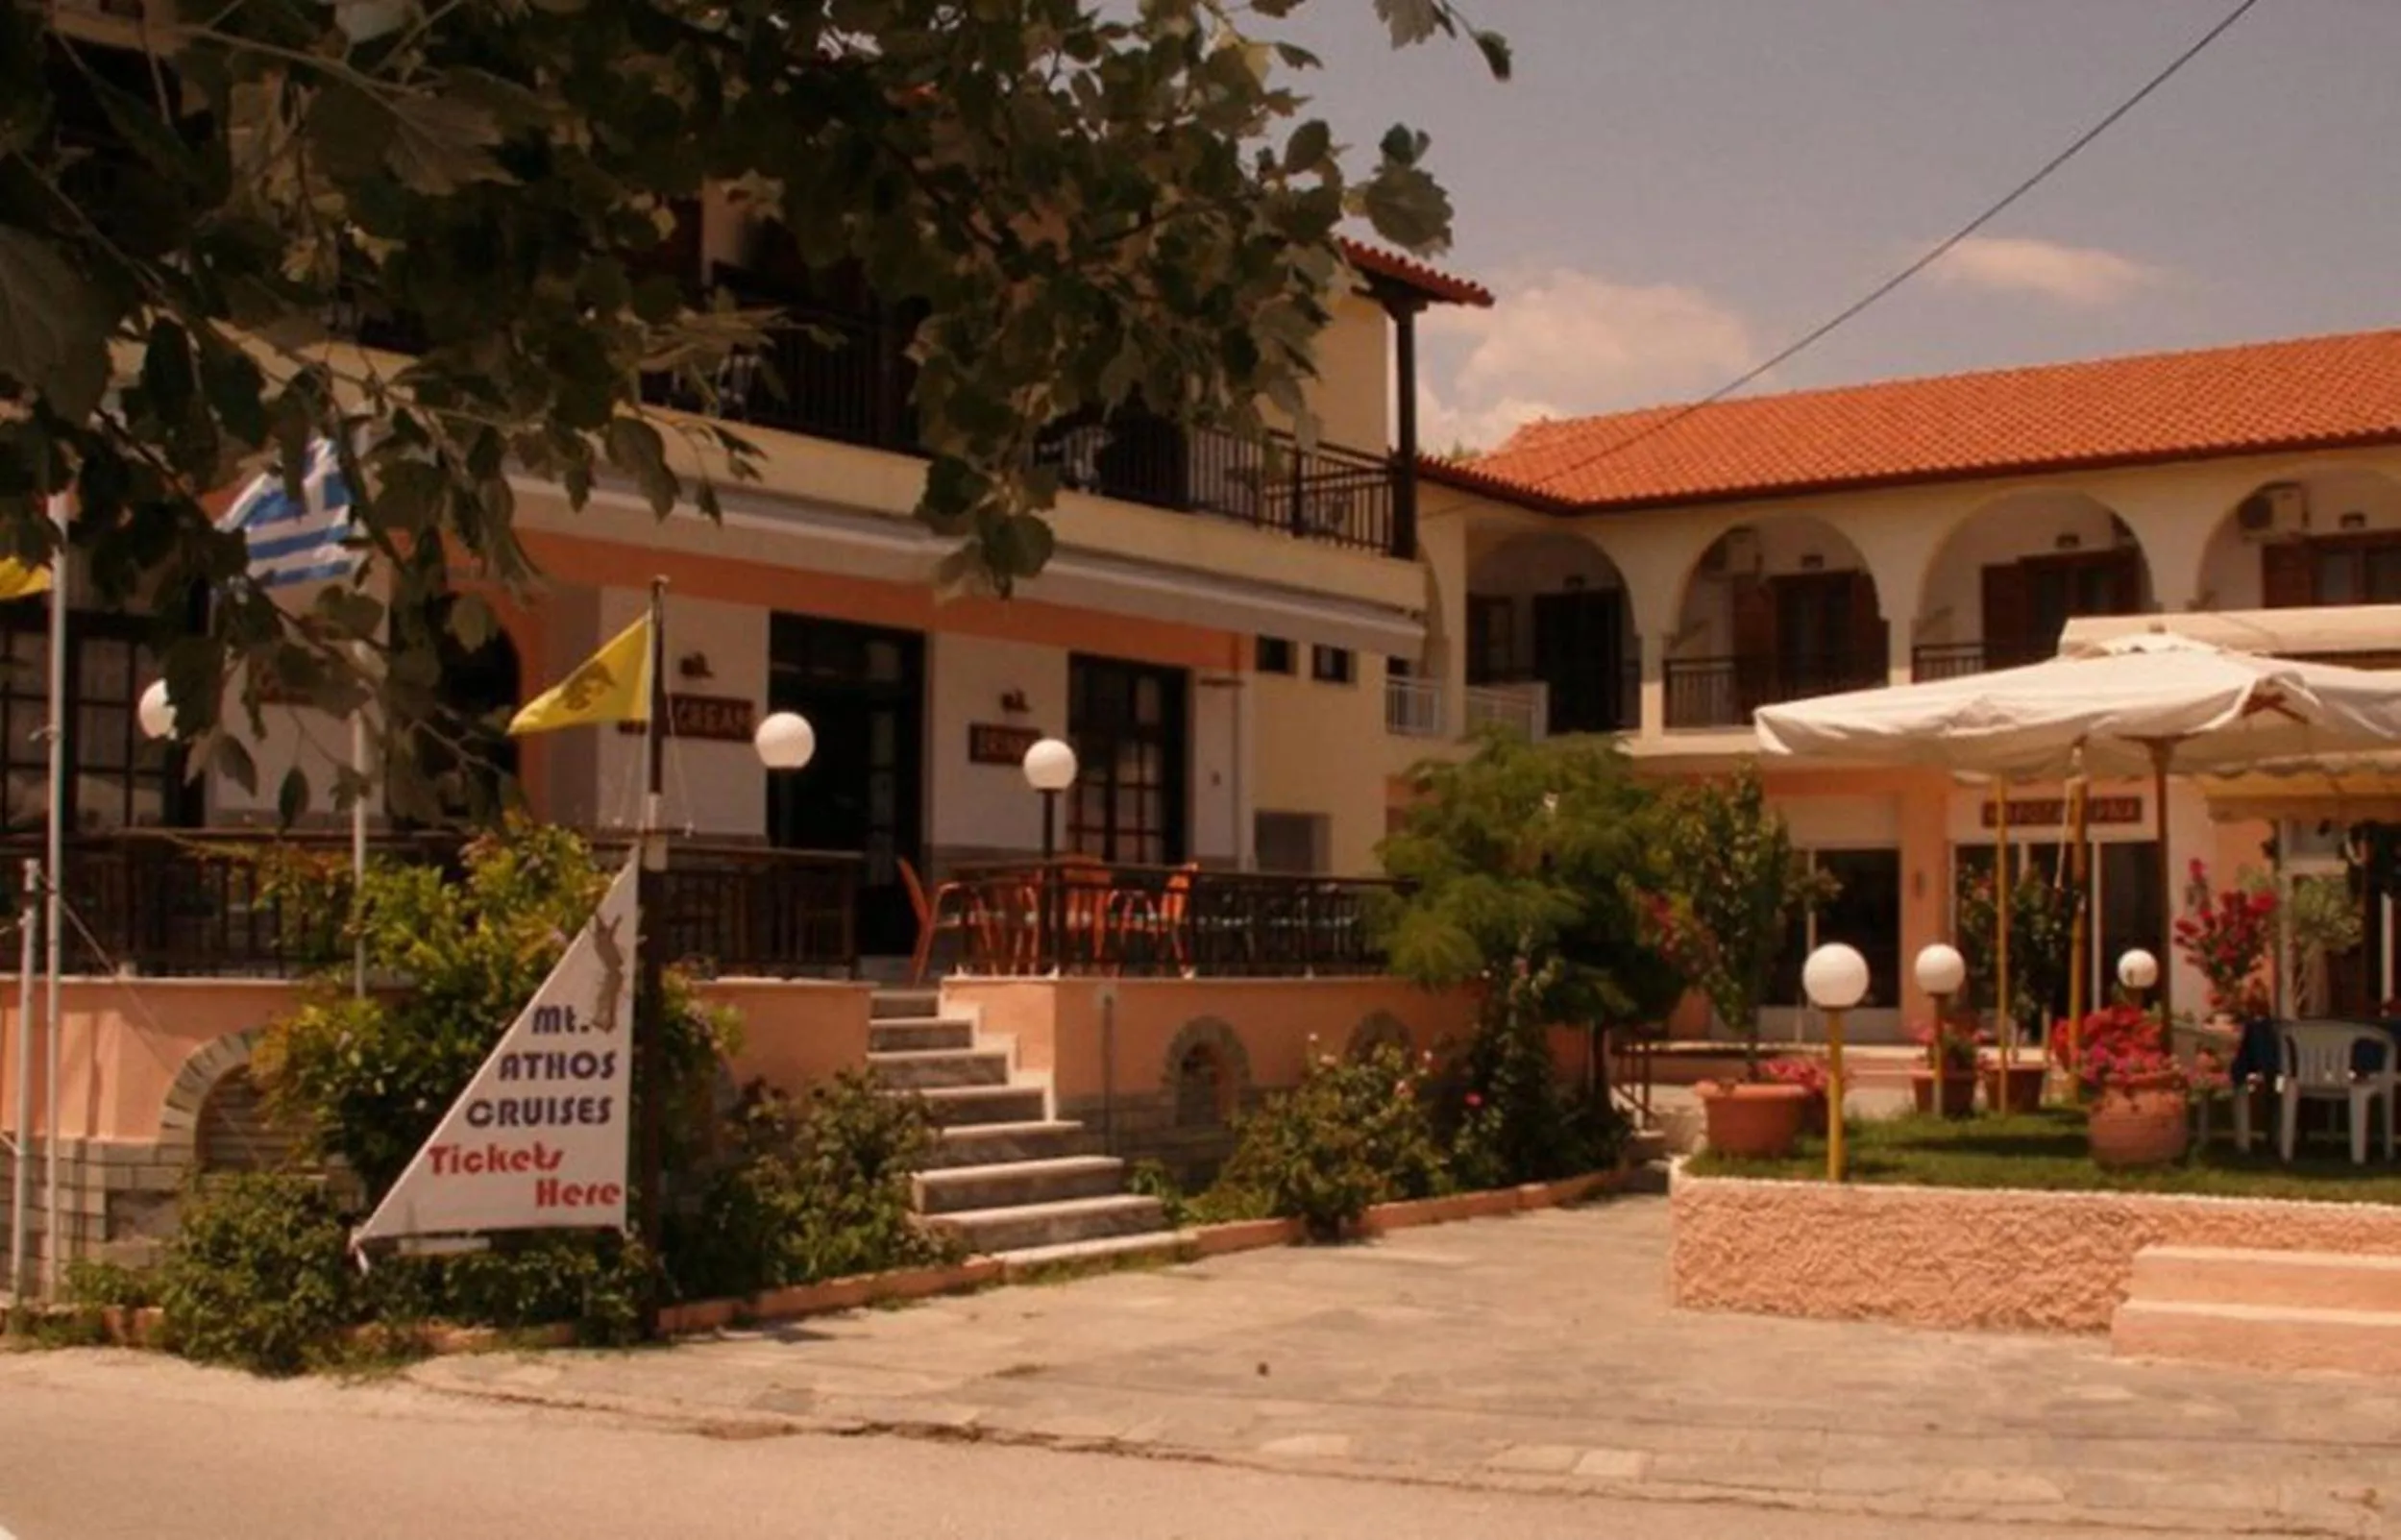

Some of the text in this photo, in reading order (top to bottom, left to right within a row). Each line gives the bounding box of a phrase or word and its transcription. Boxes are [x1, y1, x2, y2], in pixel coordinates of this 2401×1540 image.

[531, 1005, 590, 1035] Mt.
[499, 1051, 617, 1082] ATHOS
[466, 1097, 613, 1128] CRUISES
[429, 1141, 565, 1176] Tickets
[534, 1178, 621, 1209] Here
